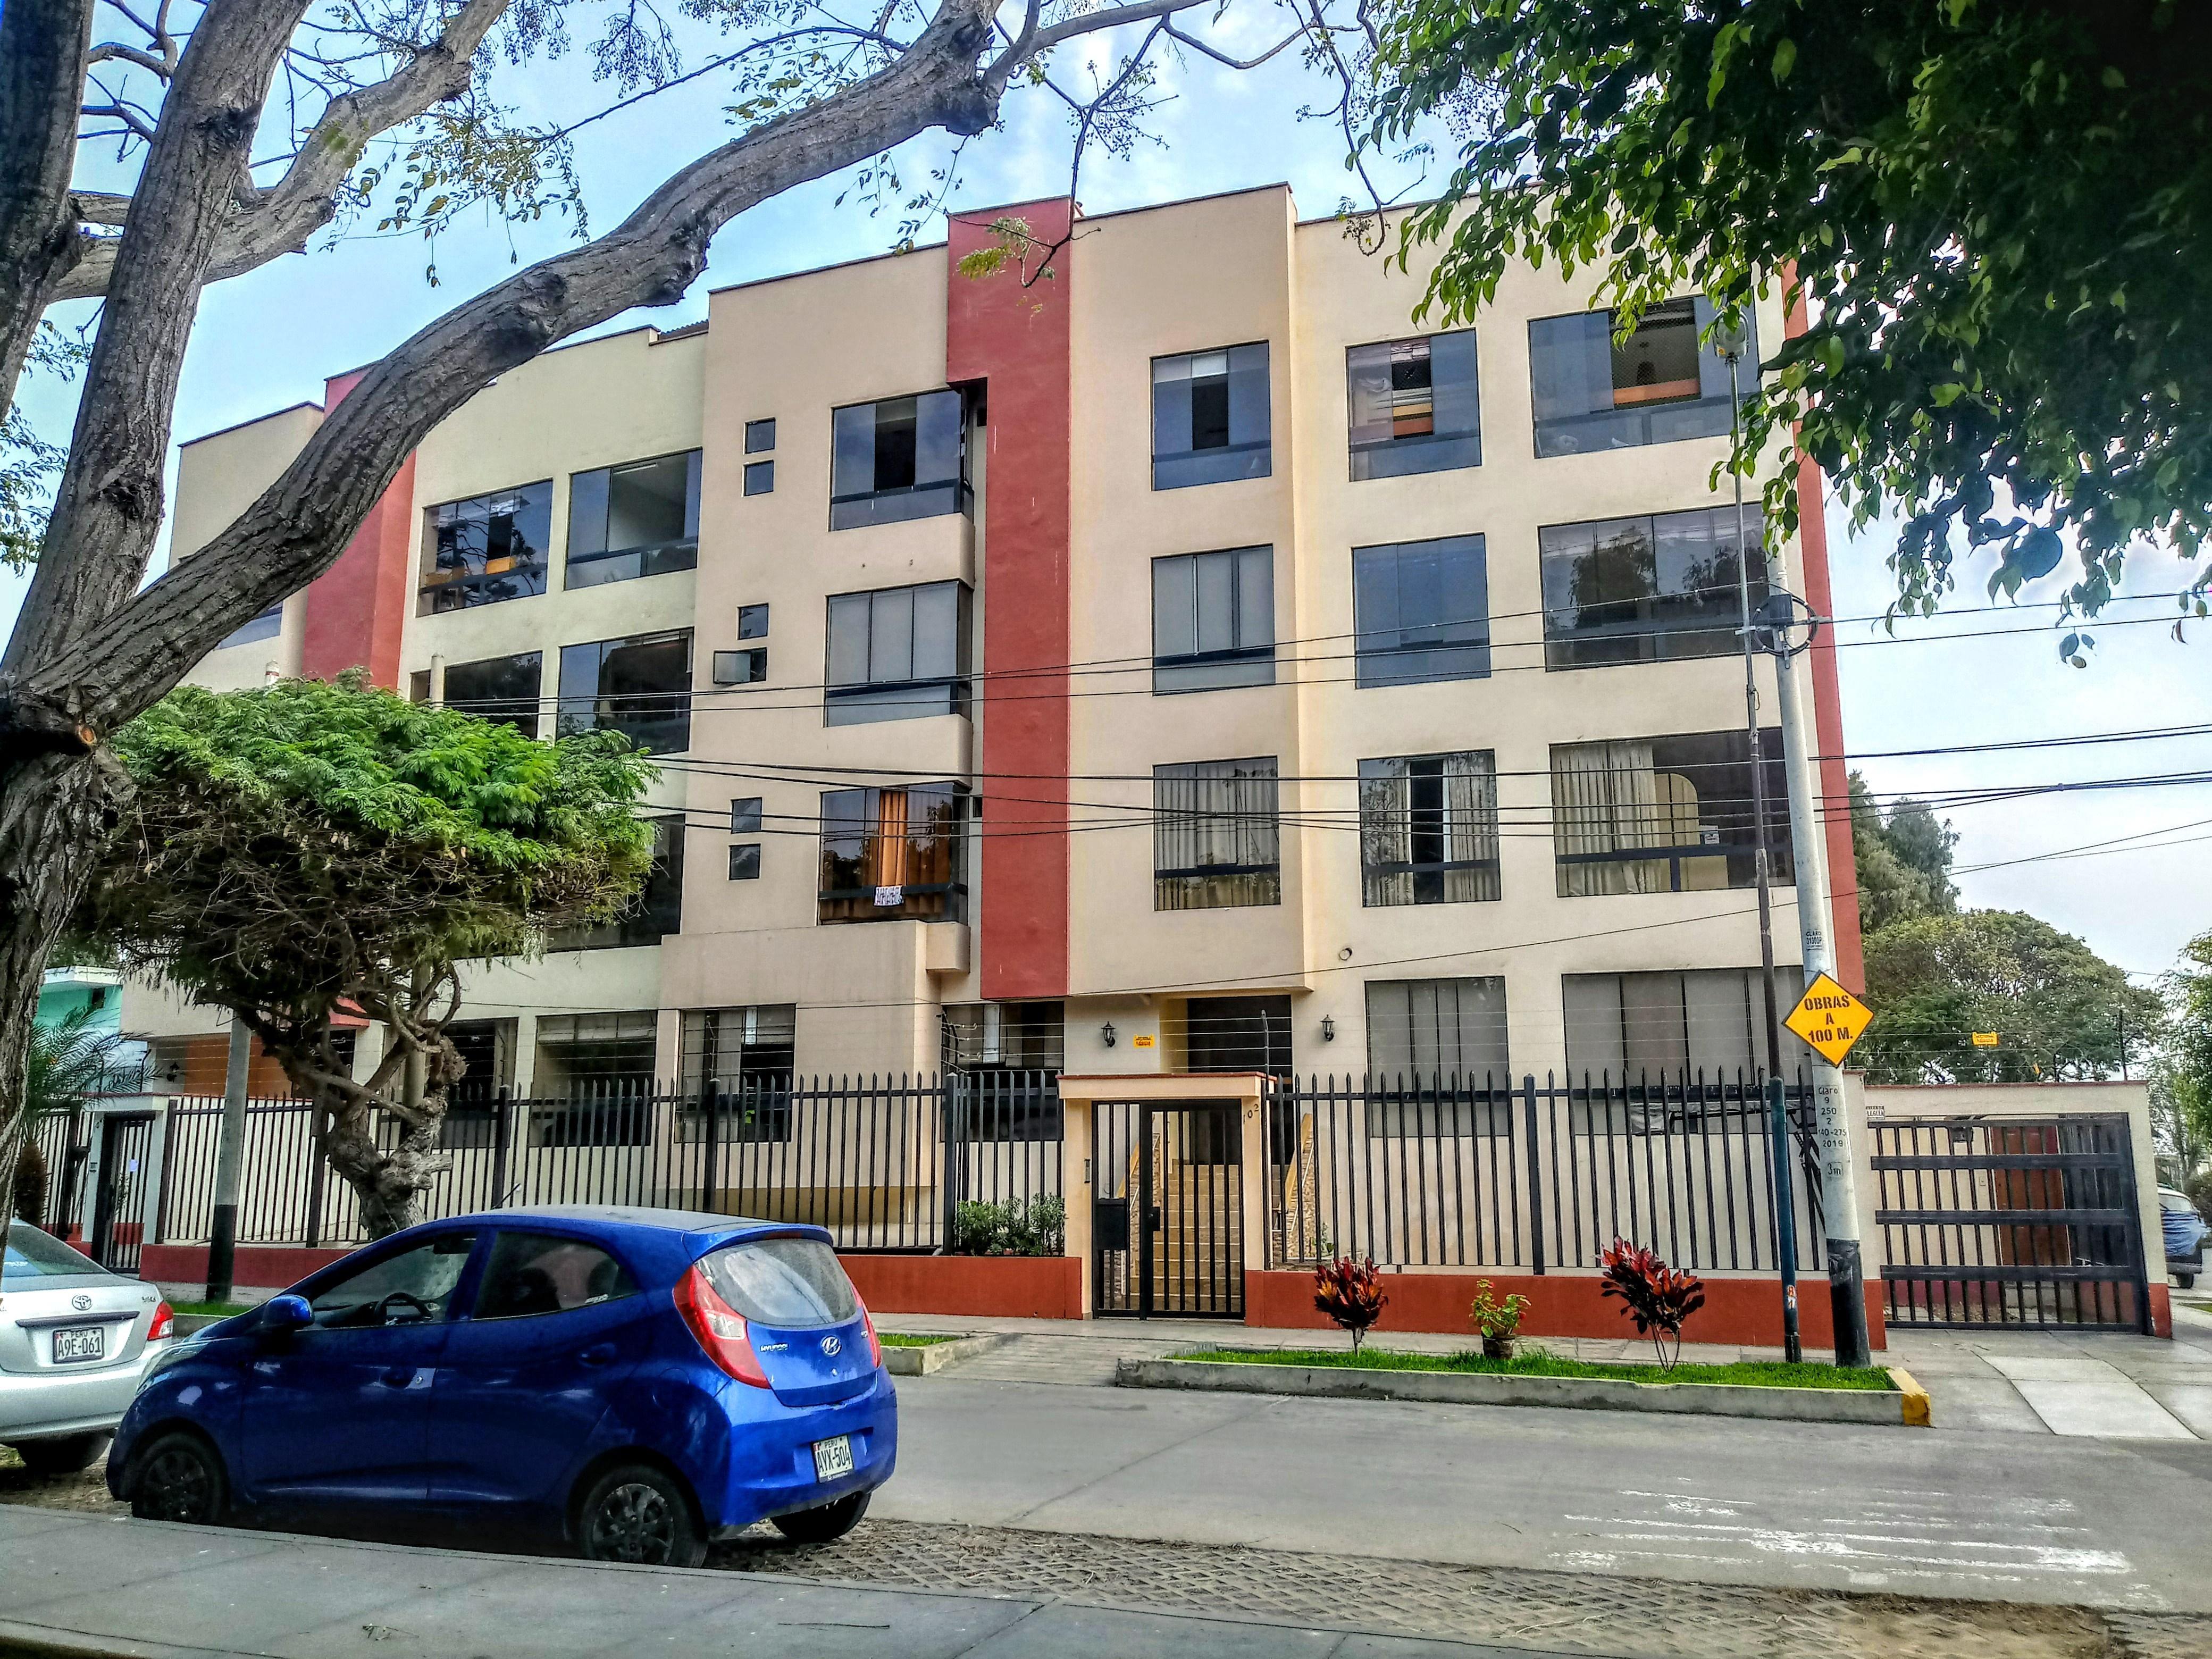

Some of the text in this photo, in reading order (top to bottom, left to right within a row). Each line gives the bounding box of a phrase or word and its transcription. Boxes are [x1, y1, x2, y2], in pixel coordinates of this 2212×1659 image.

[1804, 994, 1850, 1010] OBRAS
[1825, 1012, 1834, 1025] A
[1808, 1027, 1854, 1043] 100 M.
[1819, 1086, 1838, 1095] Claro
[1243, 1103, 1259, 1125] 102
[1821, 1107, 1837, 1116] 250
[58, 1337, 101, 1356] A9E-061
[817, 1445, 851, 1472] AYX-504
